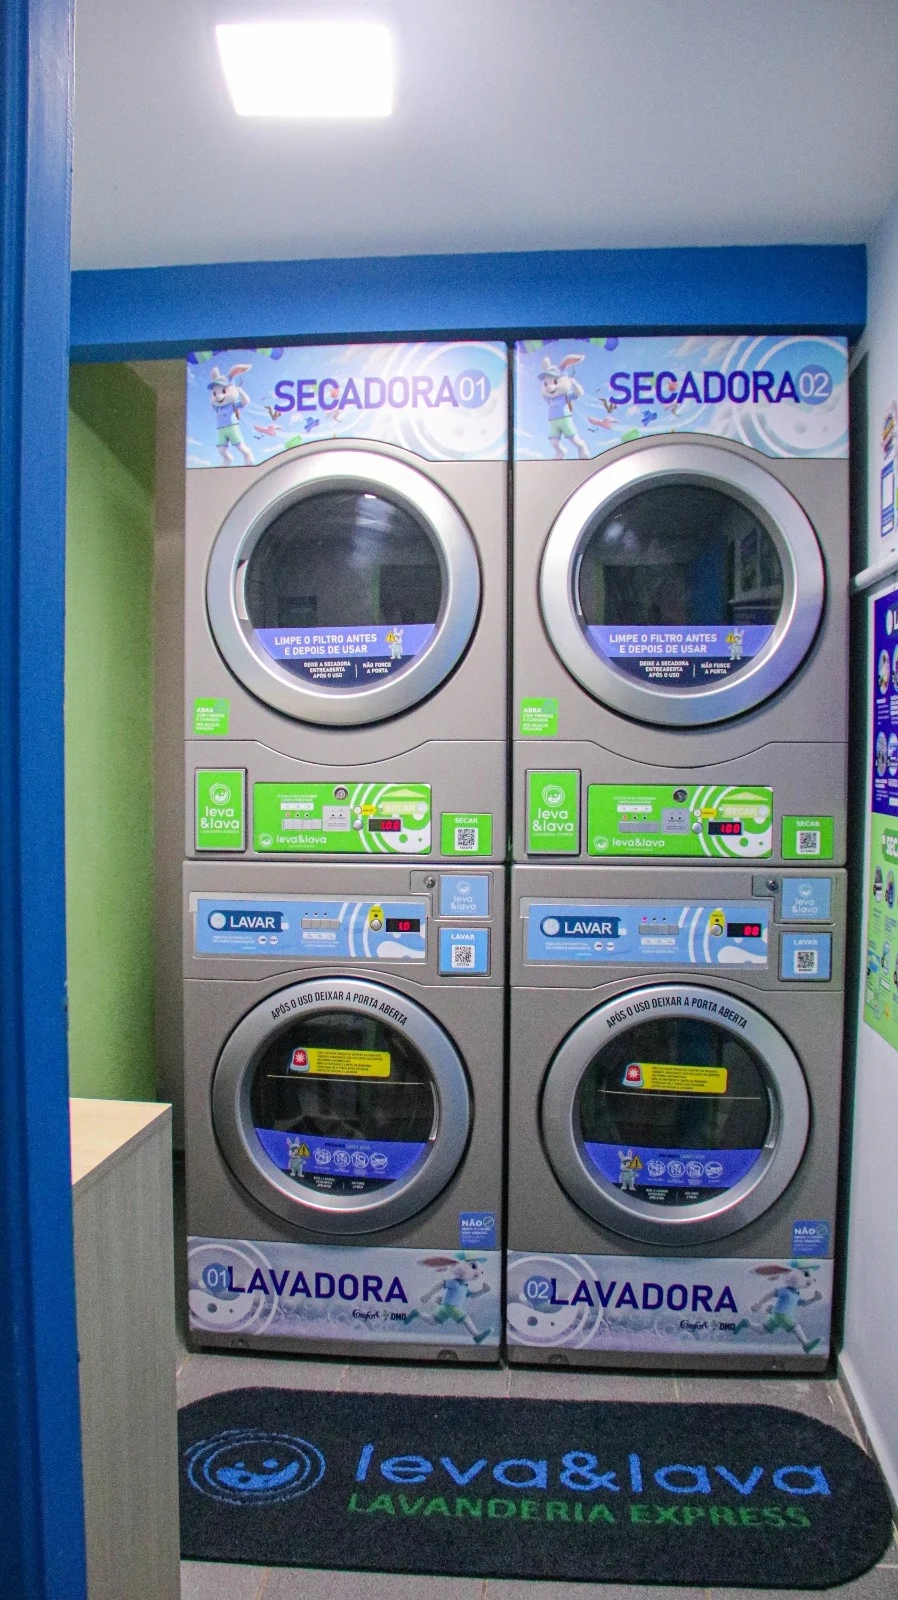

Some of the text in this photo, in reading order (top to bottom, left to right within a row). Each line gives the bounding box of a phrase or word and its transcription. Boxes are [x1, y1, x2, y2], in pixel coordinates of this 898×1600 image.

[274, 375, 486, 412] SECADORA 01
[608, 370, 829, 405] SECADORA 02
[275, 633, 377, 646] LIMPE O FILTRO ANTES
[609, 633, 718, 643] LIMPE O FILTRO ANTES
[284, 644, 368, 656] E DEPOIS DE USAR
[619, 644, 707, 654] E DEPOIS DE USAR
[205, 806, 234, 817] leva
[538, 808, 568, 820] leva
[200, 818, 239, 829] &lava
[532, 820, 574, 832] &lava
[276, 835, 327, 844] leva&lava
[612, 838, 665, 847] leva&lava
[453, 895, 473, 903] leva
[795, 898, 815, 906] leva
[450, 903, 476, 911] &lava
[791, 905, 818, 914] &lava
[230, 916, 275, 929] LAVAR
[564, 921, 612, 935] LAVAR
[271, 991, 408, 1026] APÓS O USO DEIXAR A PORTA ABERTA
[606, 996, 748, 1029] APÓS O USO DEIXAR A PORTA ABERTA
[461, 1217, 482, 1227] NÃO
[794, 1226, 816, 1235] NÃO
[207, 1265, 408, 1304] 01 LAVADORA
[526, 1277, 738, 1314] 02 LAVADORA
[355, 1442, 831, 1496] leva&lava
[348, 1493, 811, 1528] LAVANDERIA EXPRESS
